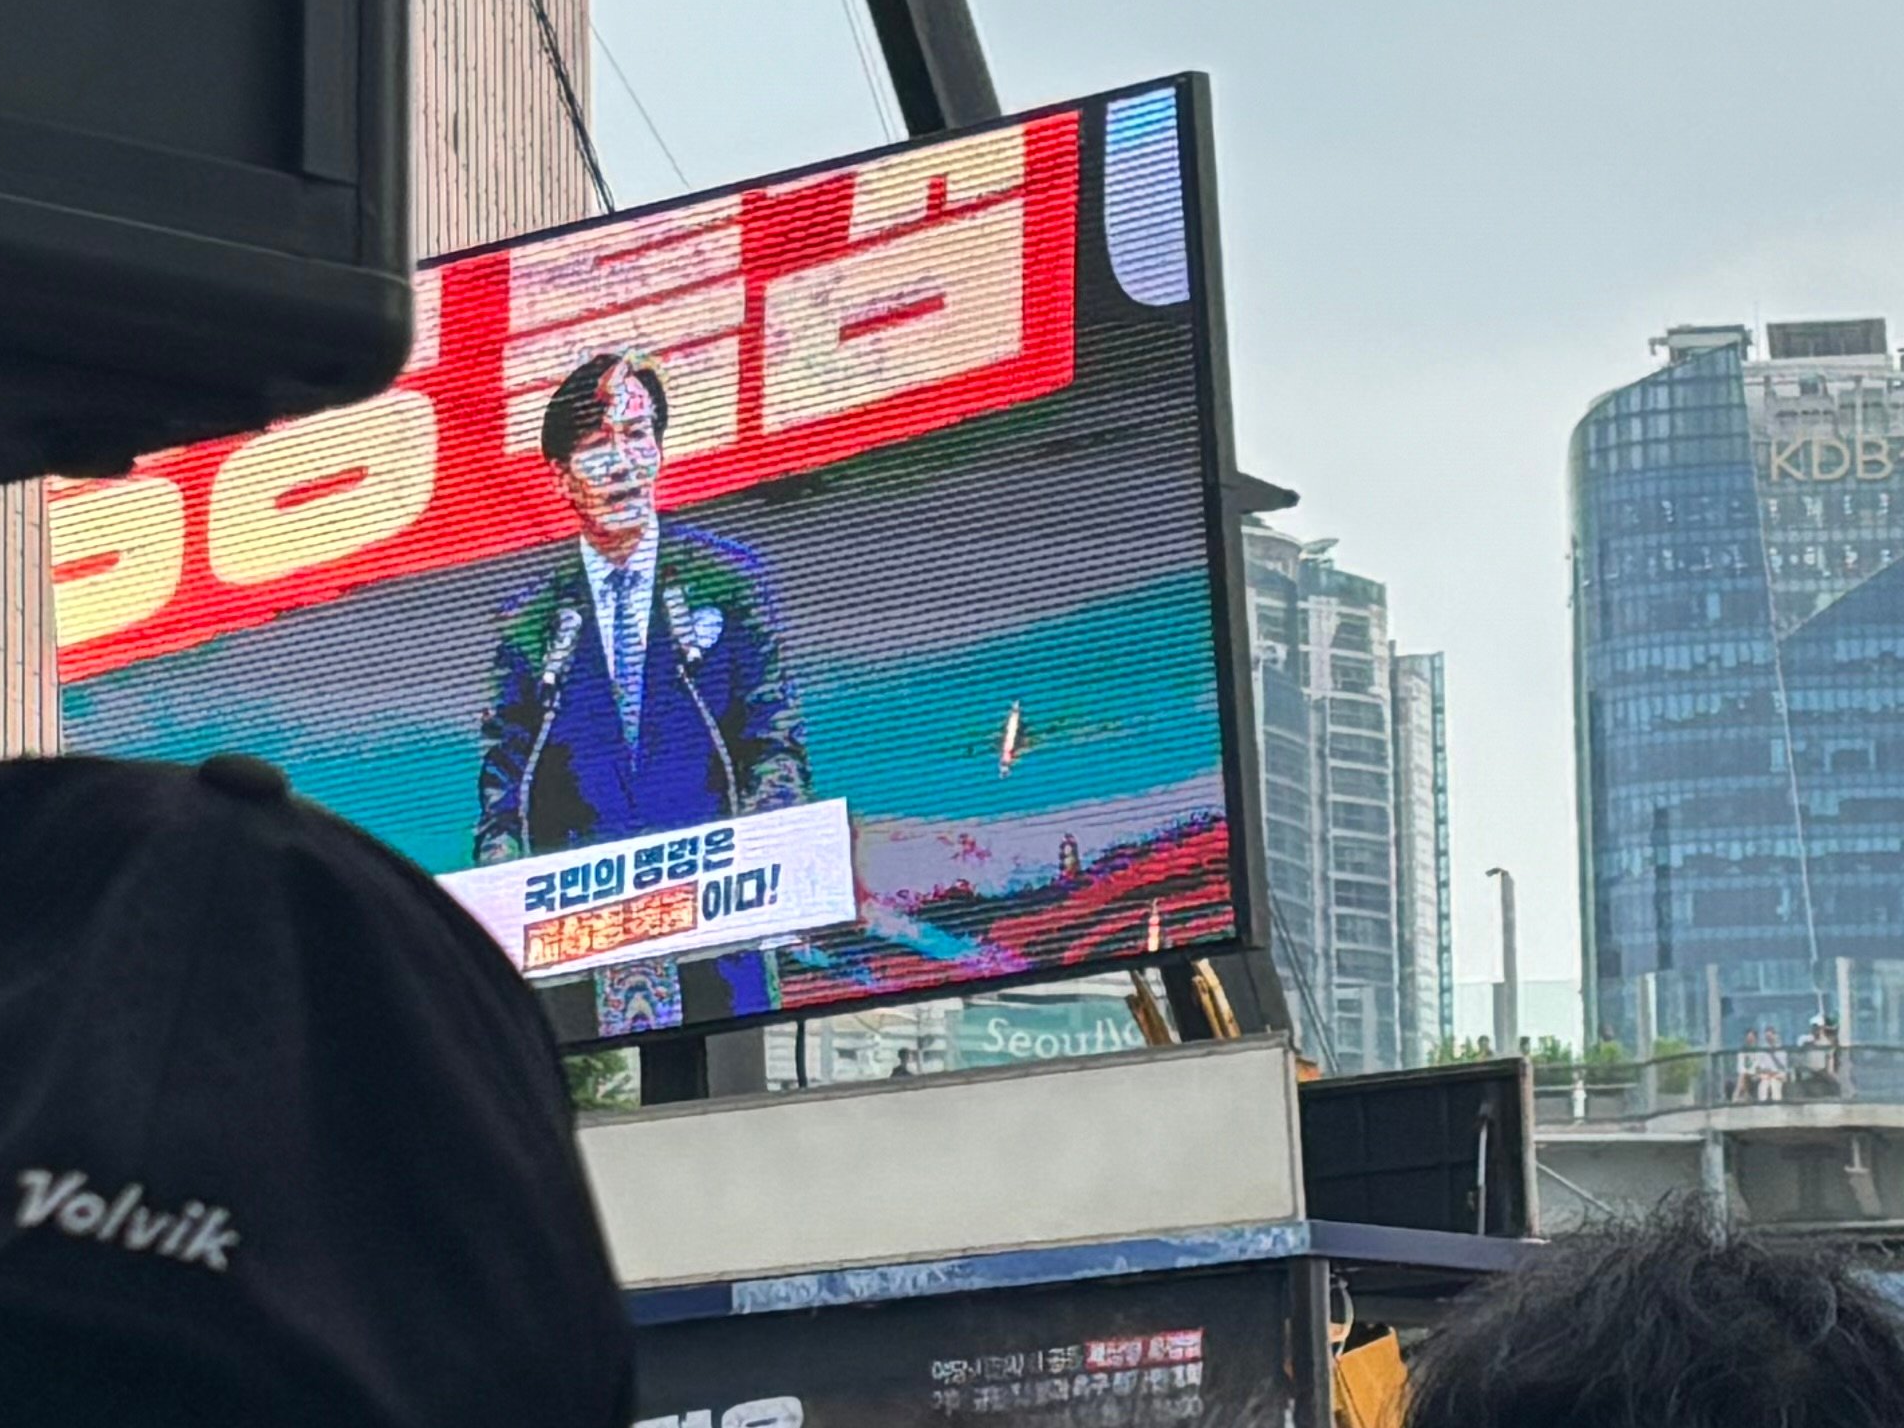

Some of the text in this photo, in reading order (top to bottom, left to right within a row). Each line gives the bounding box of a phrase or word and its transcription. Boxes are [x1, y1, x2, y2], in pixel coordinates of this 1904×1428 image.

[525, 827, 736, 912] 국민의 명령은
[703, 864, 781, 921] 이다!
[17, 1169, 241, 1271] Volvik
